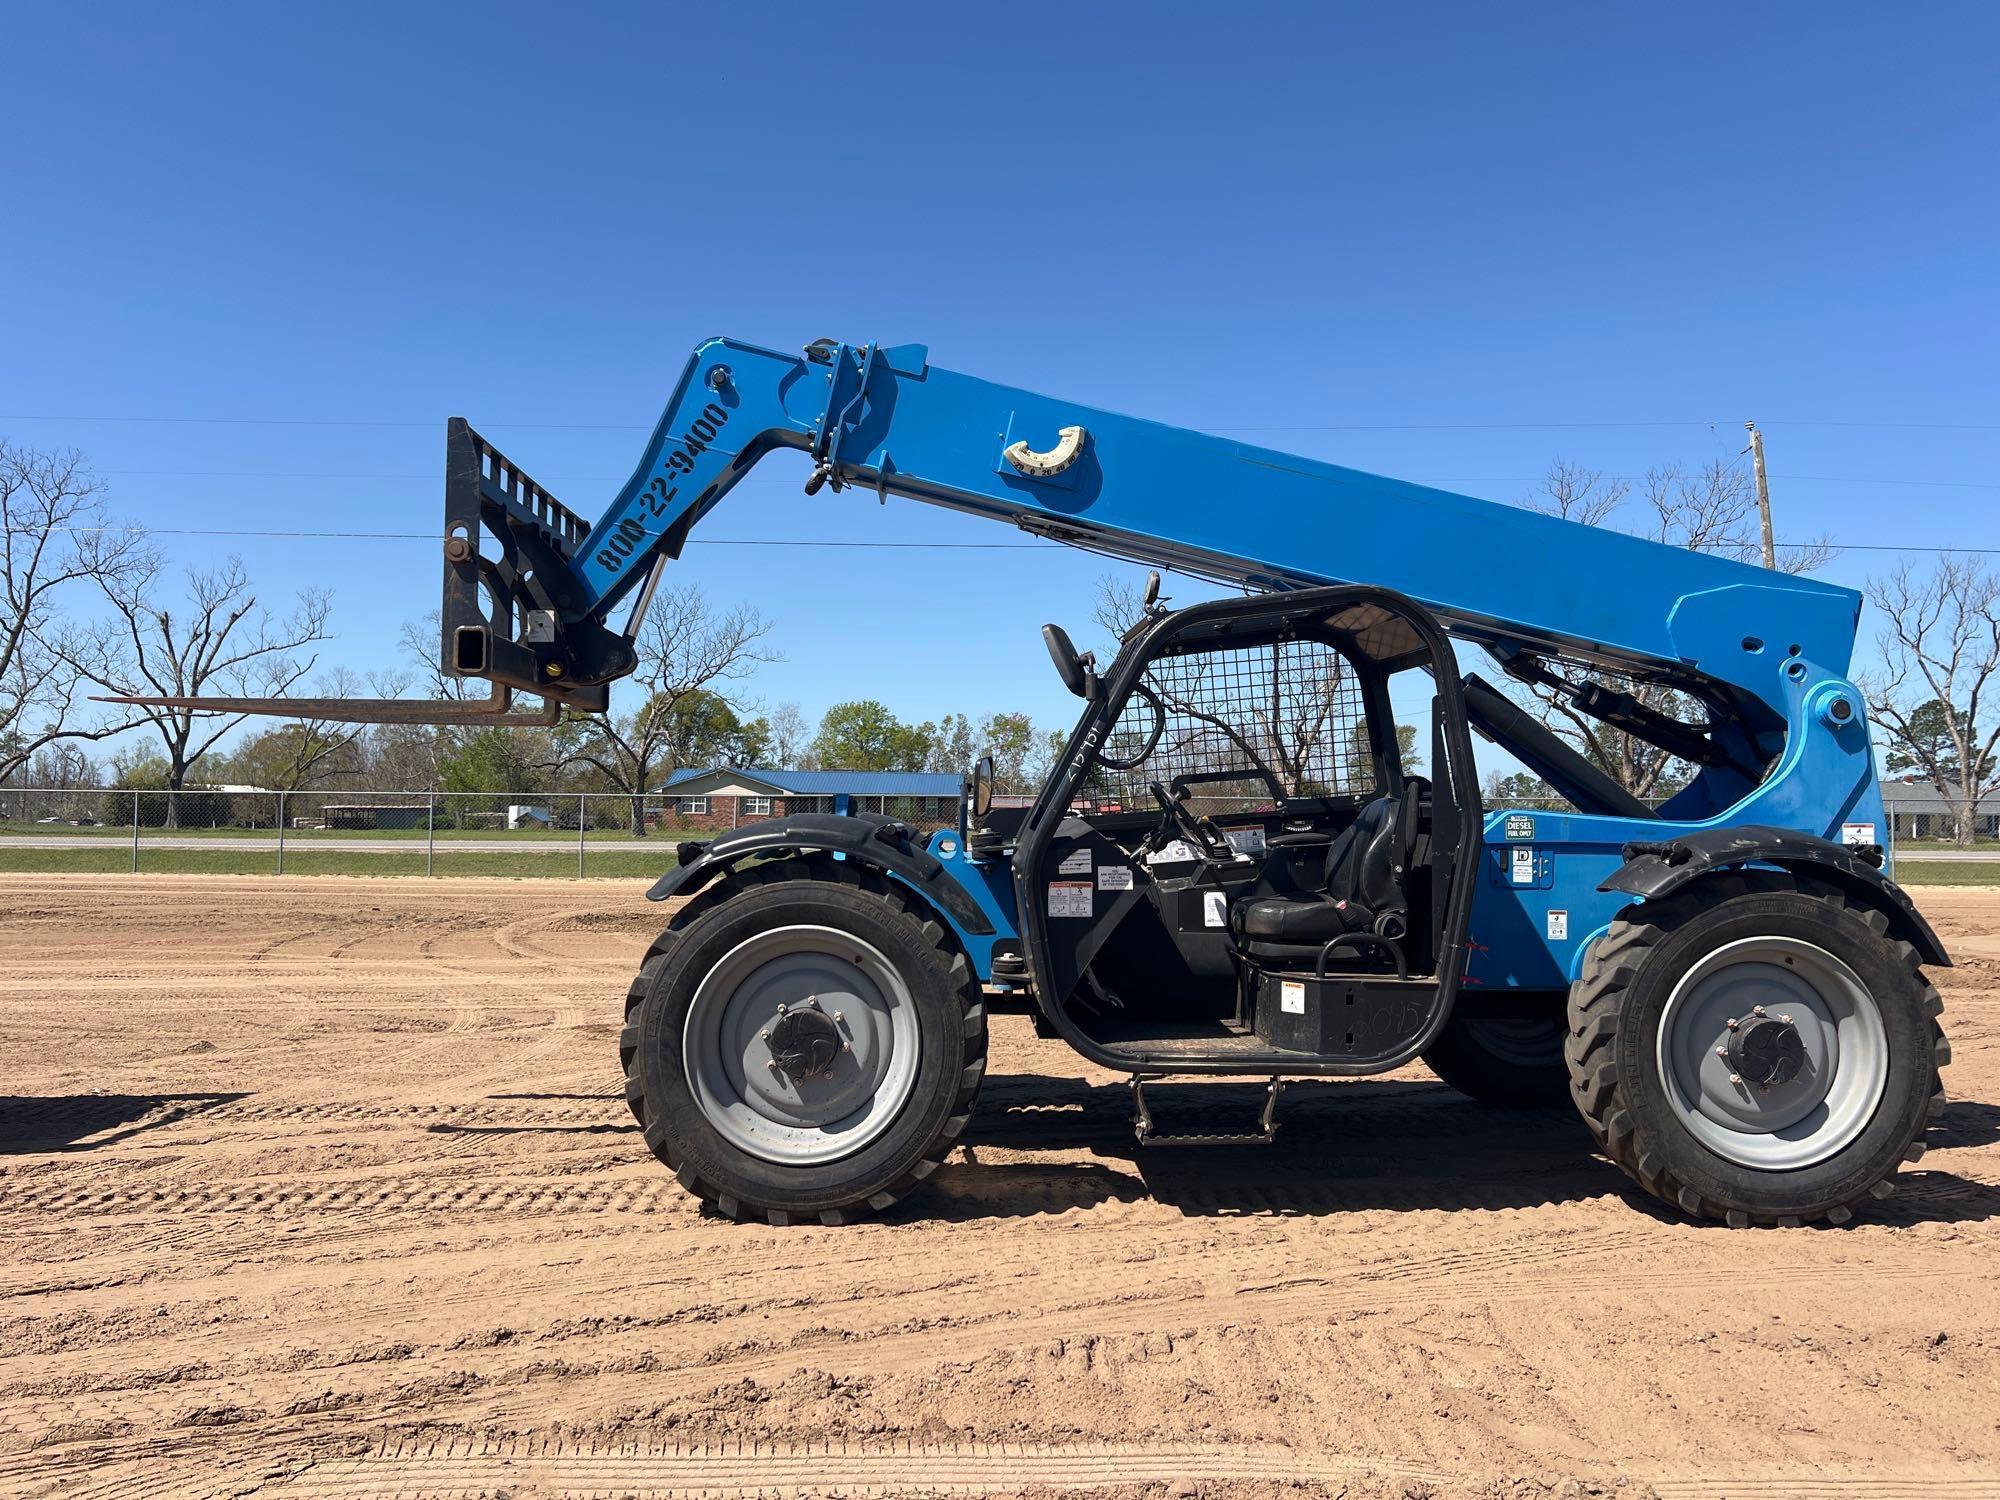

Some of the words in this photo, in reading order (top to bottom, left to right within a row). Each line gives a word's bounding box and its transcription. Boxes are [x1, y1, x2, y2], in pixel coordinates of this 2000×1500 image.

[1056, 464, 1065, 472] 40
[596, 403, 729, 573] 800-22-9400
[1507, 822, 1533, 830] DIESEL
